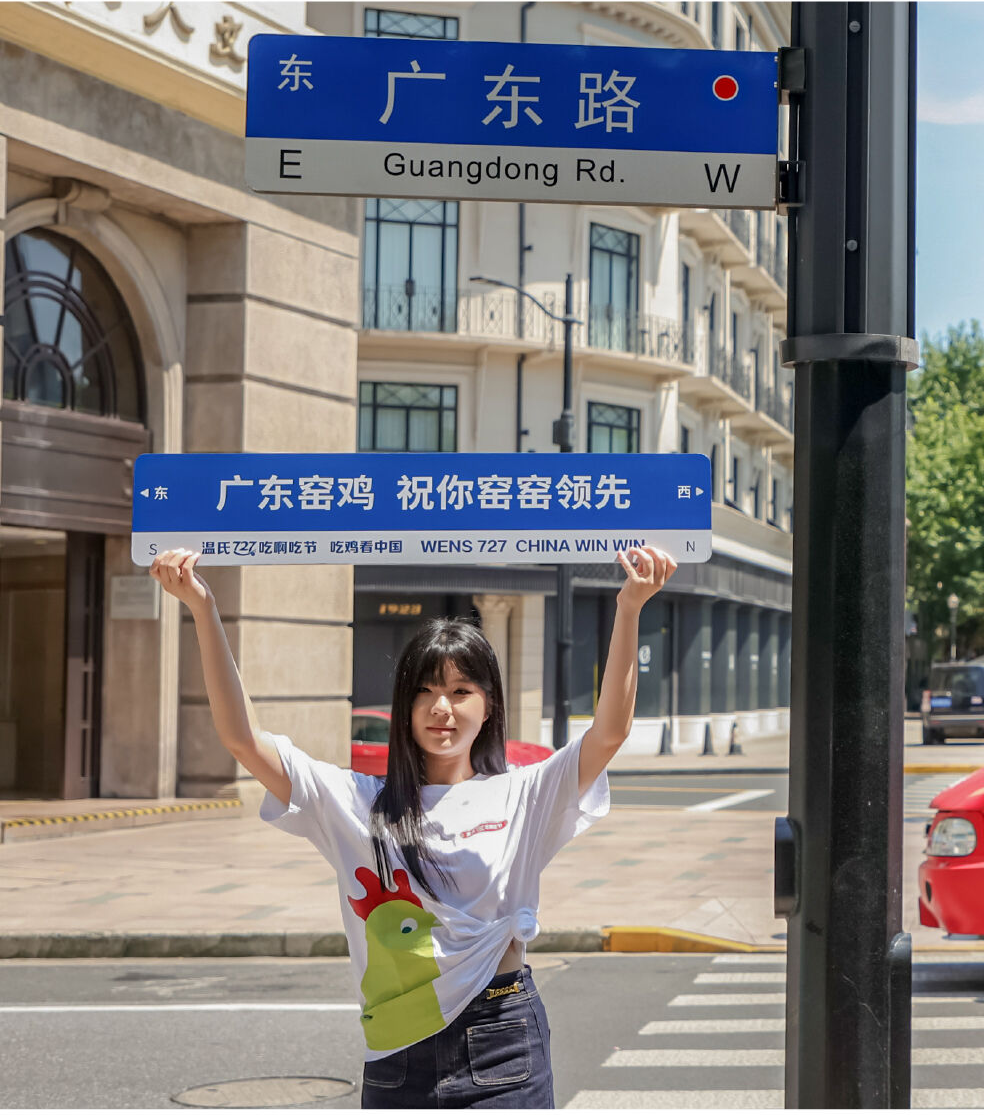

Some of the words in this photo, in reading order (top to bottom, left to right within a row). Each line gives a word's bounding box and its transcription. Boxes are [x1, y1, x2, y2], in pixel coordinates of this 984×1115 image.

[278, 54, 314, 91] 东
[378, 60, 640, 133] 广东路
[280, 149, 302, 179] E
[383, 152, 559, 187] Guangdong
[575, 158, 625, 183] Rd.
[704, 163, 741, 193] W
[154, 486, 169, 501] 东
[216, 474, 375, 511] 广东窑鸡
[396, 474, 631, 511] 祝你窑窑领先
[678, 485, 691, 499] 西
[148, 543, 158, 556] S
[330, 540, 403, 554] 吃鸡看中国
[420, 540, 473, 553] WENS
[477, 540, 507, 553] 727
[515, 539, 570, 553] CHINA
[574, 539, 608, 552] WIN
[613, 538, 645, 552] WIN
[686, 541, 696, 552] N
